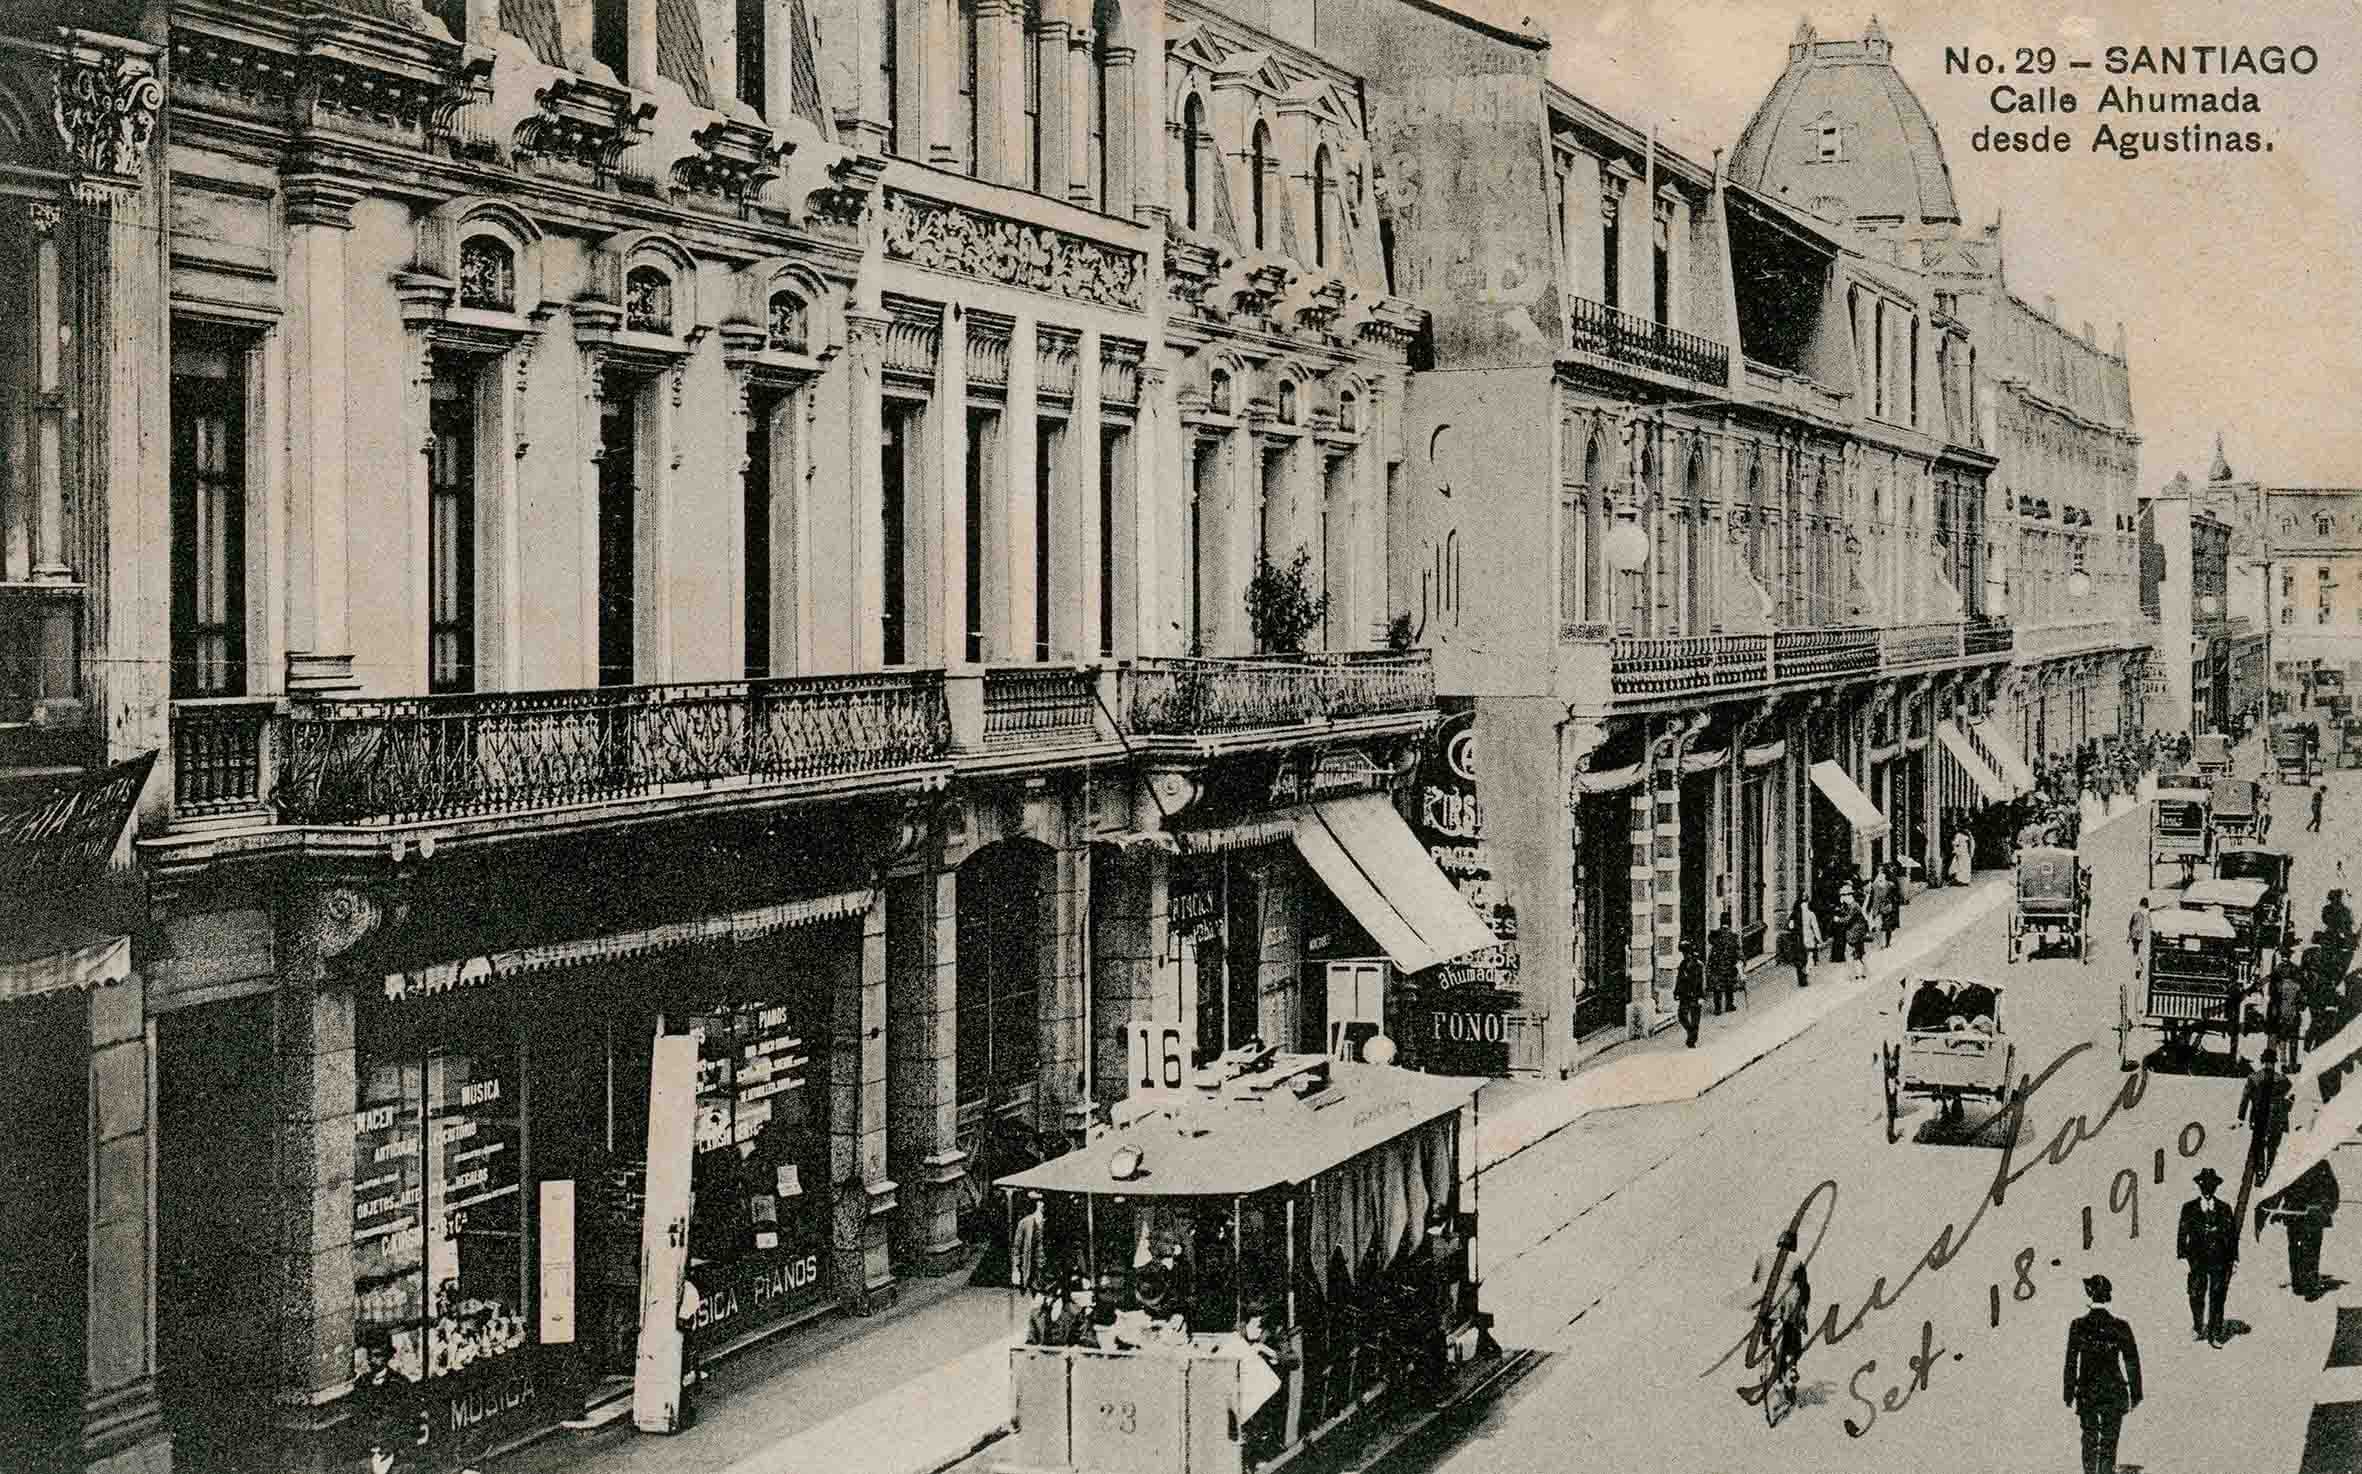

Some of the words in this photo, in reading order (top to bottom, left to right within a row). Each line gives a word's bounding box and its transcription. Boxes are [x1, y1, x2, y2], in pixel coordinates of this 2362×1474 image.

[1438, 964, 1496, 991] ahumad
[1139, 1028, 1182, 1089] 16
[2081, 1120, 2206, 1252] 1910
[753, 1254, 817, 1305] PIANOS
[451, 1377, 534, 1433] MUSICA
